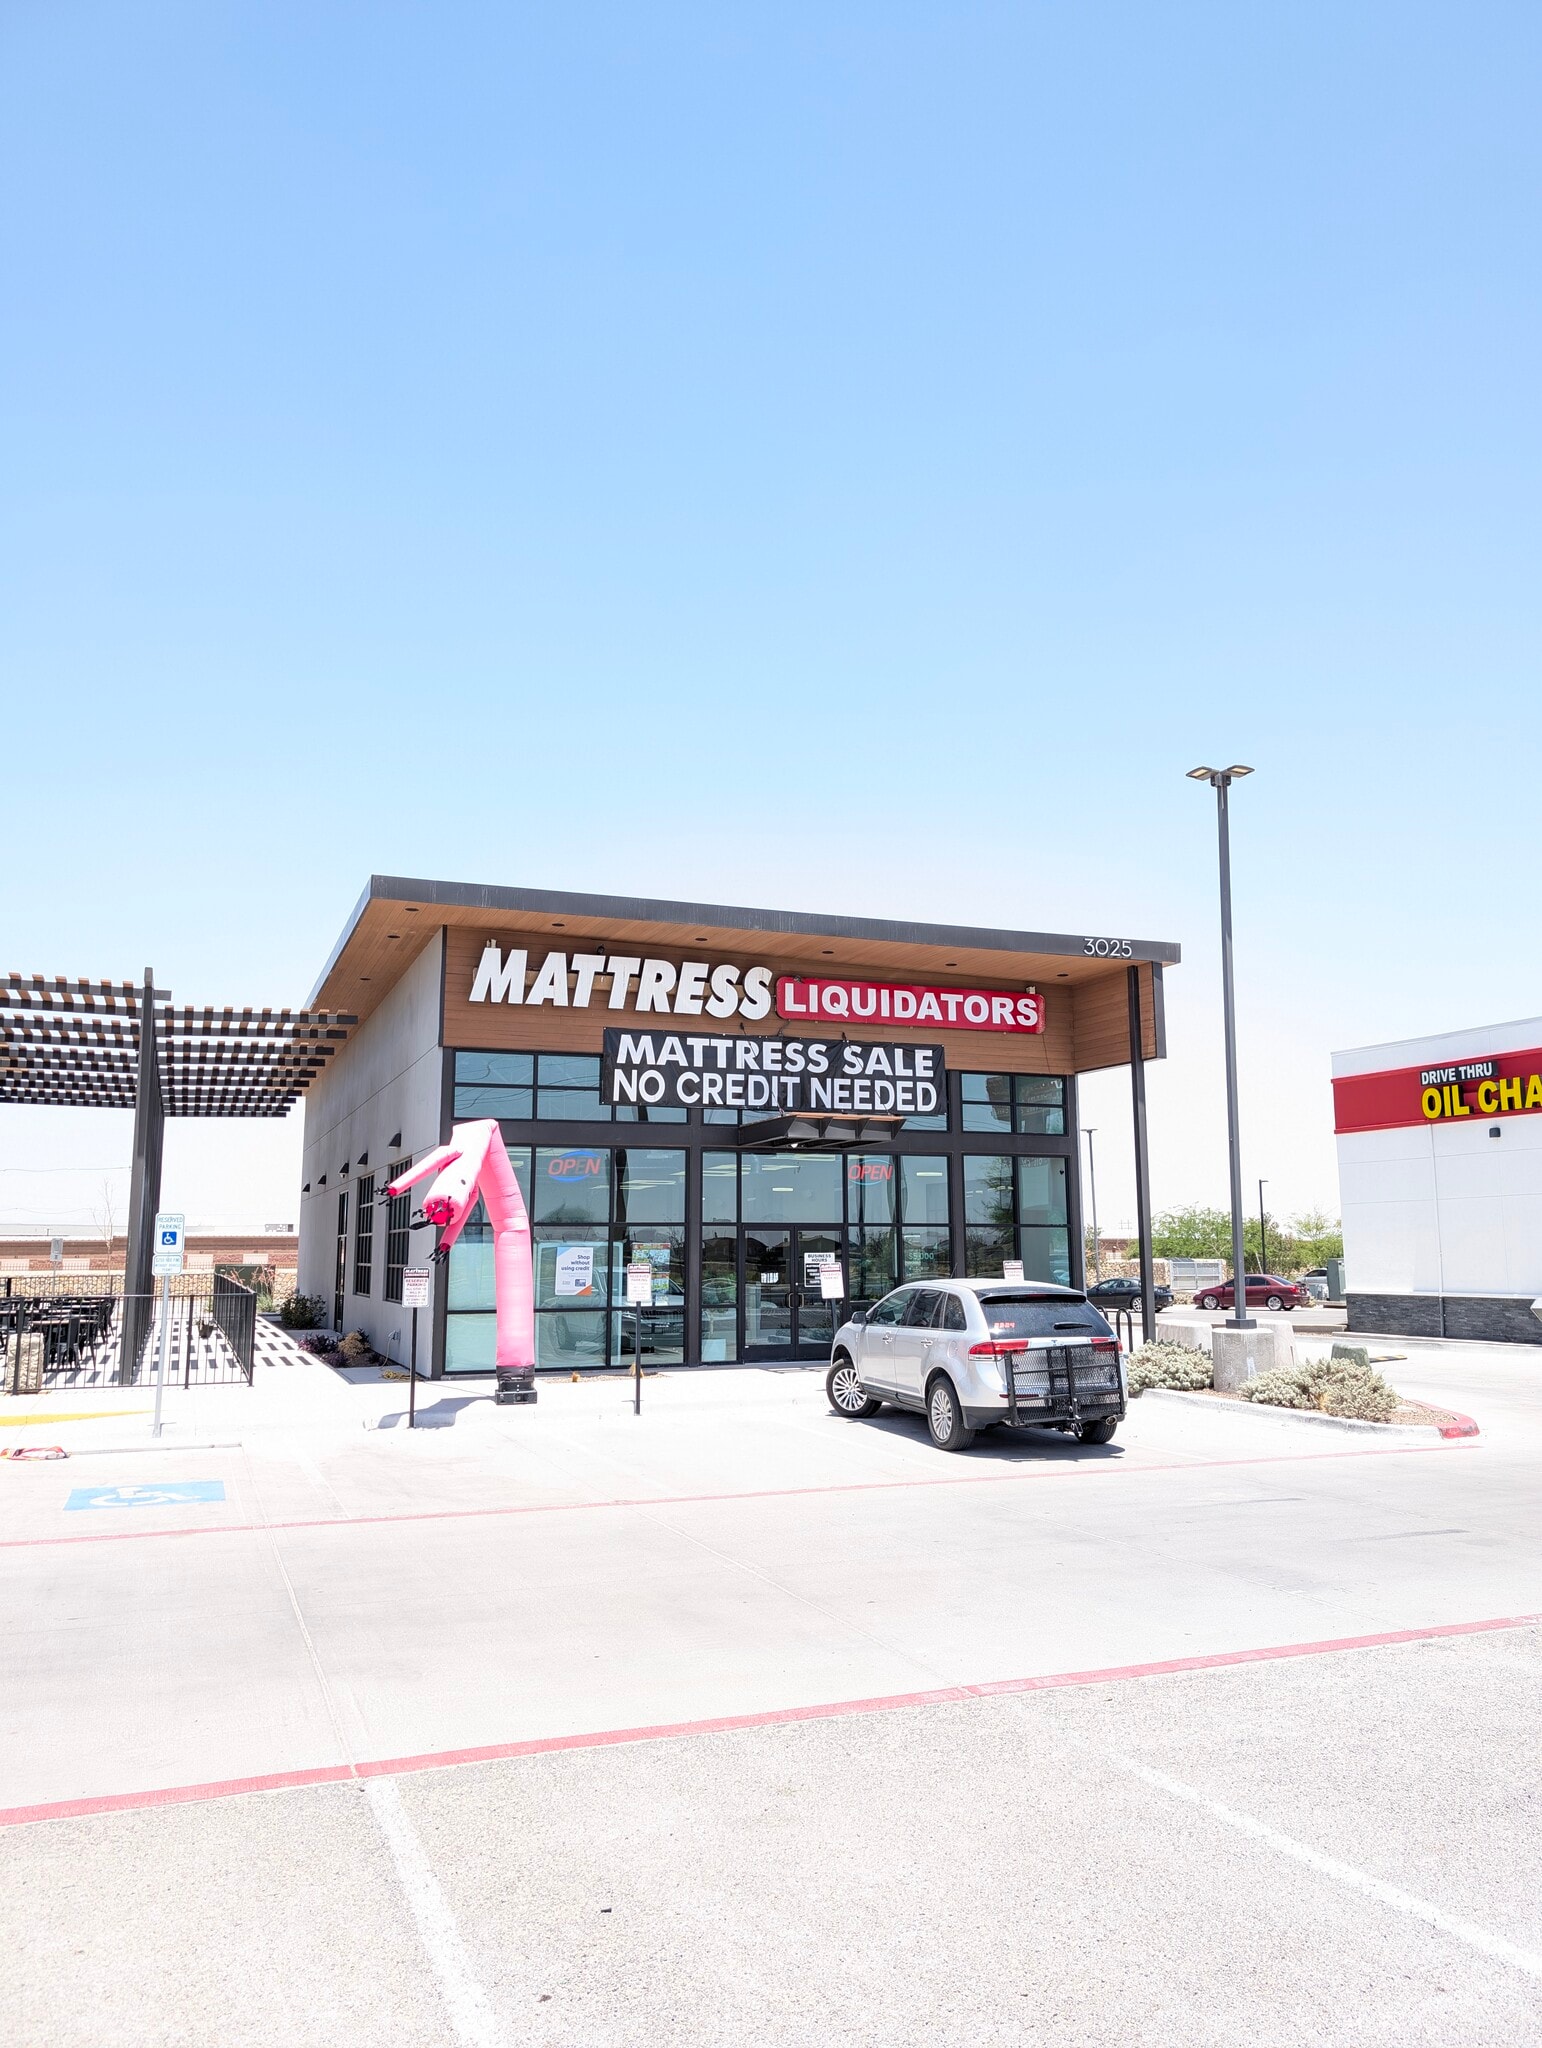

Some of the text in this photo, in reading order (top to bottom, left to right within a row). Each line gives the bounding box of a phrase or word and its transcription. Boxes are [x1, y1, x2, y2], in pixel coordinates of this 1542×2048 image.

[1083, 938, 1132, 957] 3025
[468, 947, 1039, 1027] MATTRESS LIQUIDATORS
[616, 1034, 934, 1078] MATTRESS SALE
[1421, 1062, 1493, 1086] DRIVE THRU
[613, 1068, 938, 1112] NO CREDIT NEEDED
[1421, 1084, 1470, 1119] OIL
[548, 1158, 602, 1176] OPEN
[848, 1165, 893, 1180] OPEN
